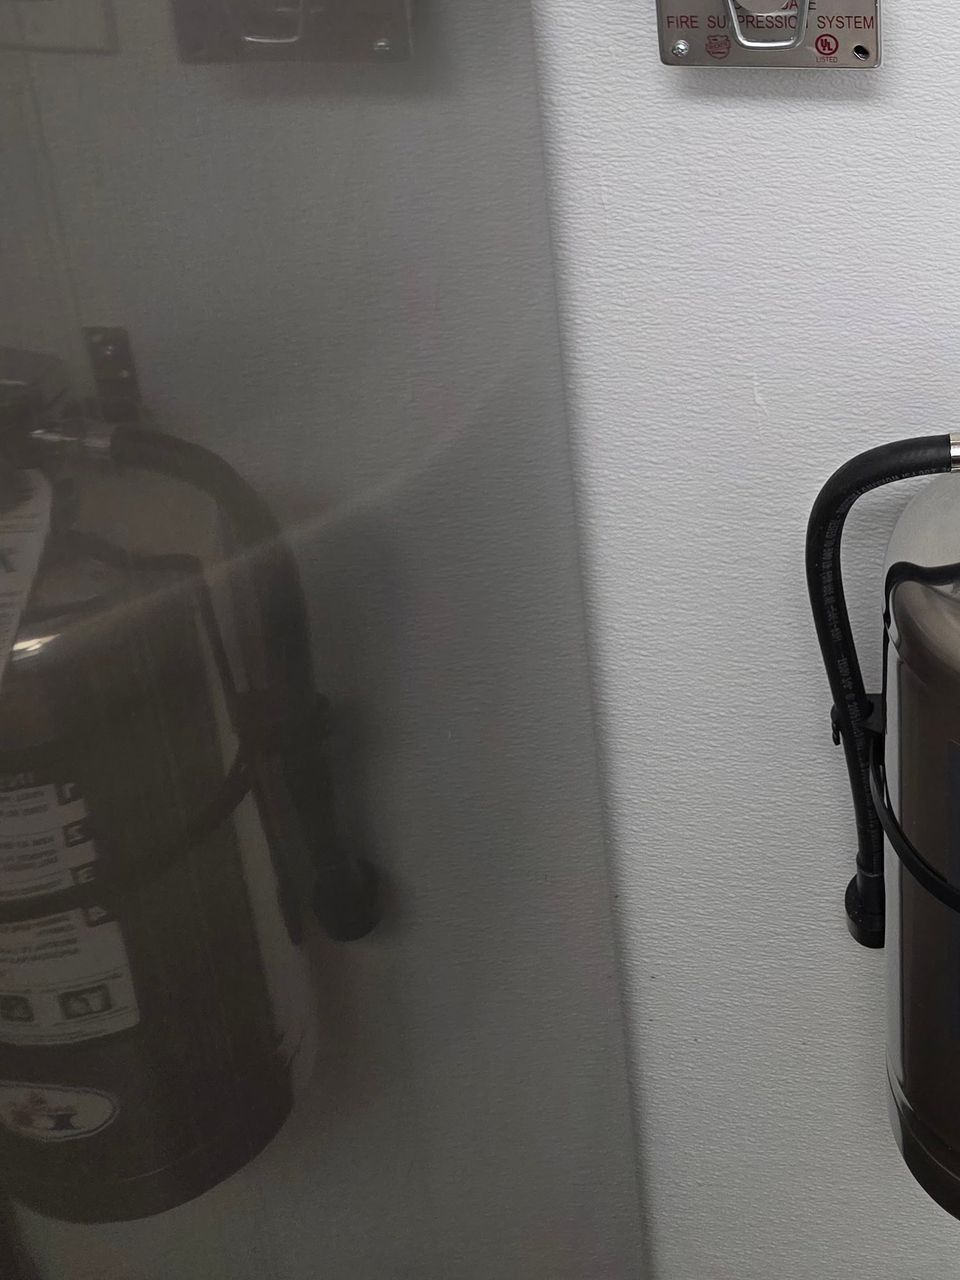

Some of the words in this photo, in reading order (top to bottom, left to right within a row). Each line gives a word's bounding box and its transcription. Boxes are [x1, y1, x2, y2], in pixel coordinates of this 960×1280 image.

[666, 16, 699, 28] FIRE
[707, 15, 808, 29] SUPRESSIO
[816, 16, 874, 29] SYSTEM
